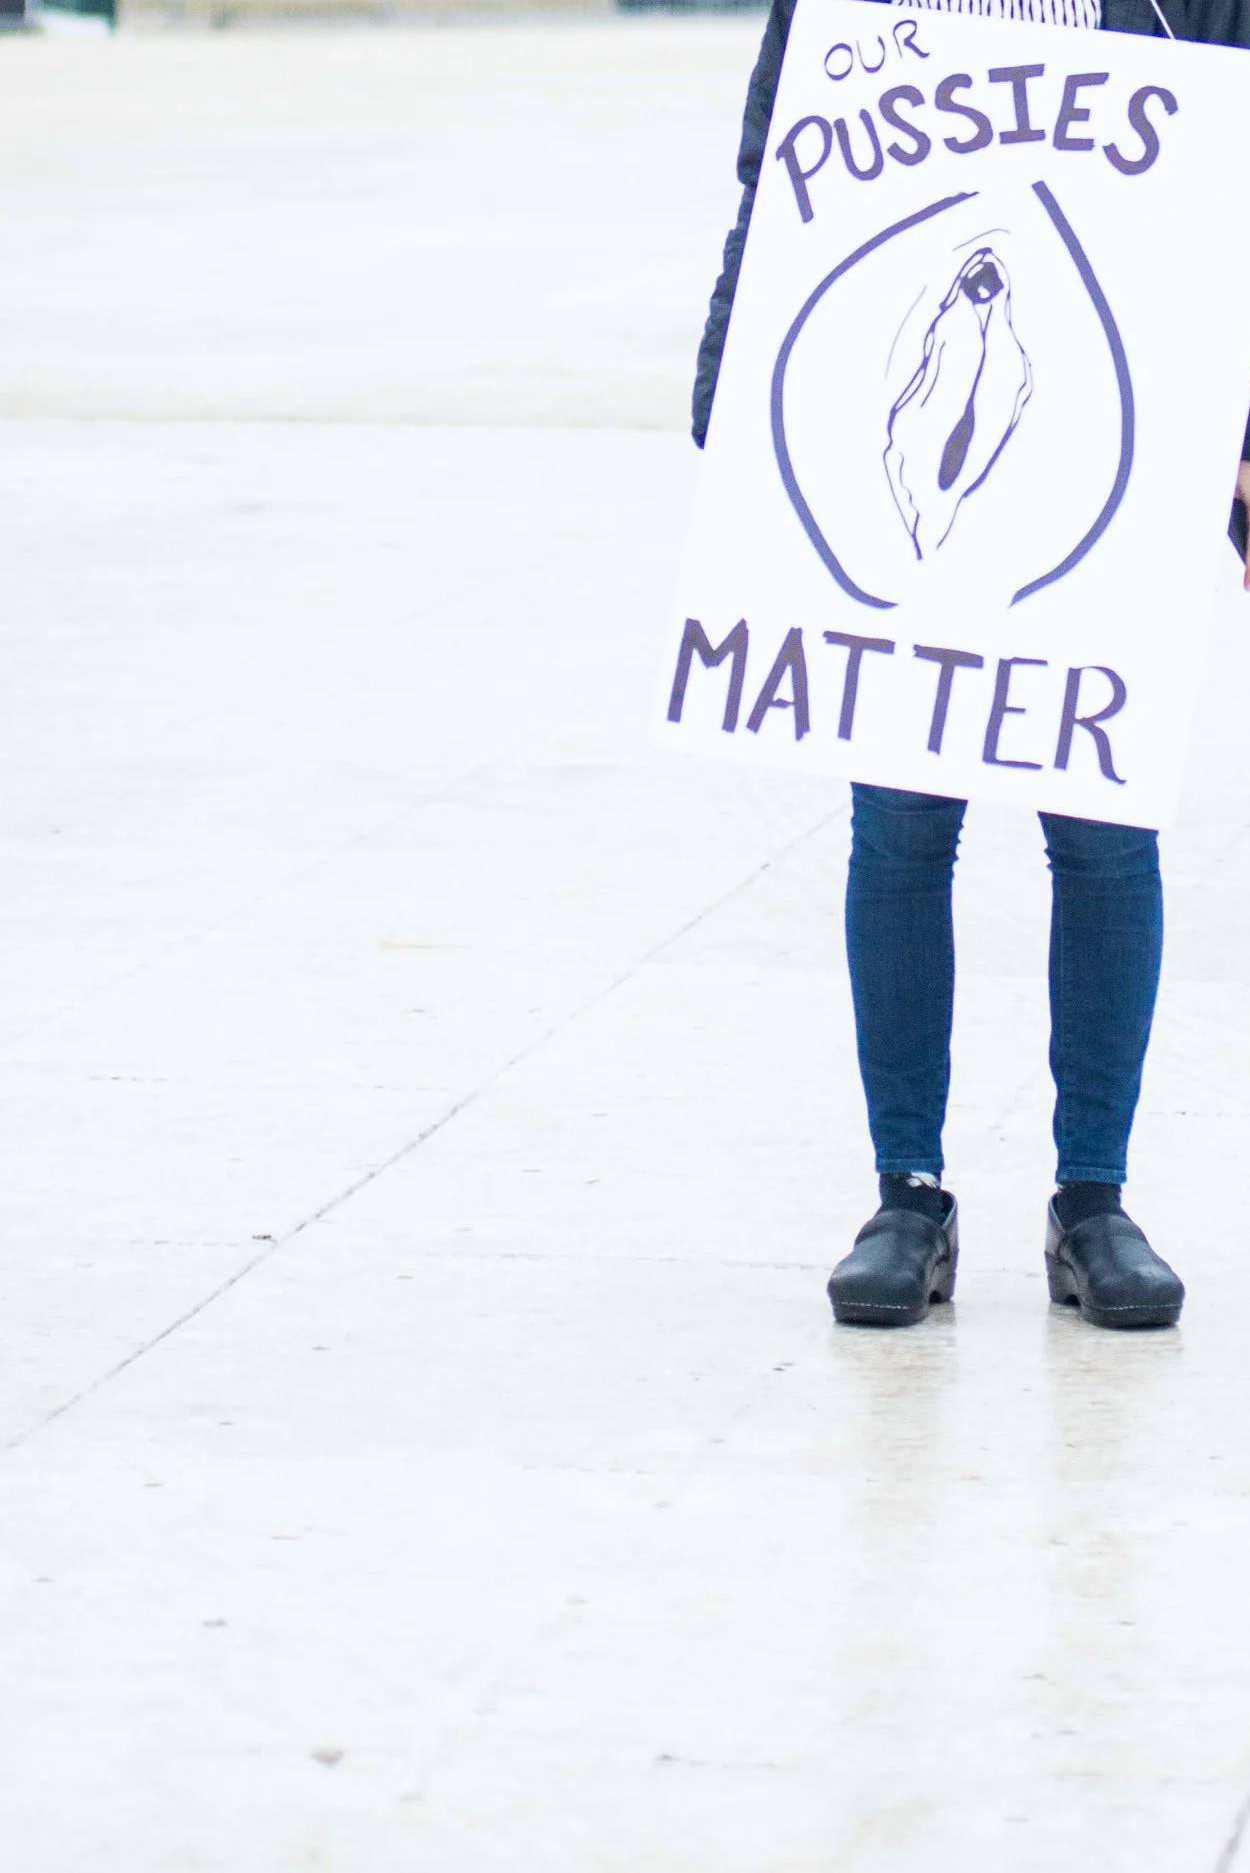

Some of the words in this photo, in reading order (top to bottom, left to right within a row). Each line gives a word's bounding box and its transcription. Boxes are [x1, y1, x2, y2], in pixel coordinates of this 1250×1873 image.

[823, 18, 931, 82] OUR
[775, 62, 1180, 225] PUSSIES
[666, 616, 1128, 786] MATTER
